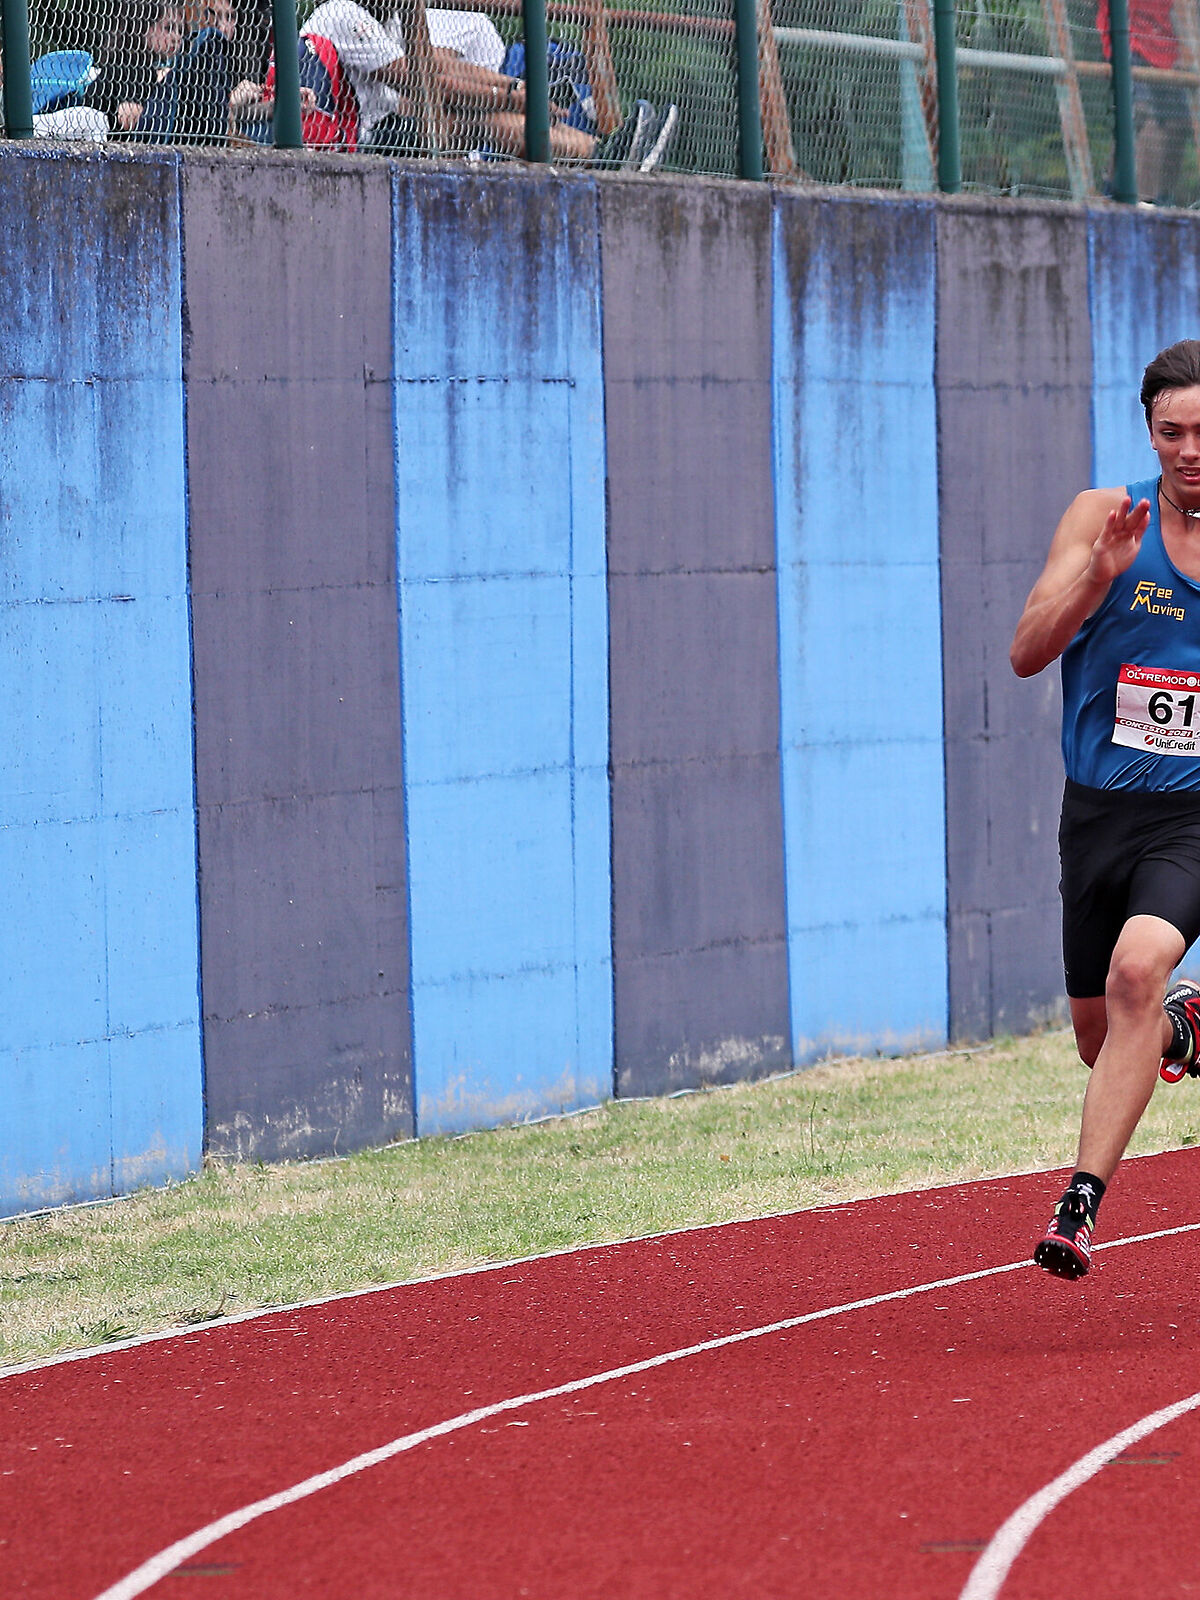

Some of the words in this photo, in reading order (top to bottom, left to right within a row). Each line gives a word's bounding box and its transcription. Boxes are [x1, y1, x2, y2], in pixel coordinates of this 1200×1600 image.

[1134, 580, 1173, 599] Free
[1130, 594, 1185, 621] Moving
[1148, 691, 1195, 726] 61
[1120, 719, 1165, 735] CONCESIO
[1167, 730, 1192, 738] 2021
[1155, 738, 1195, 751] UniCredit
